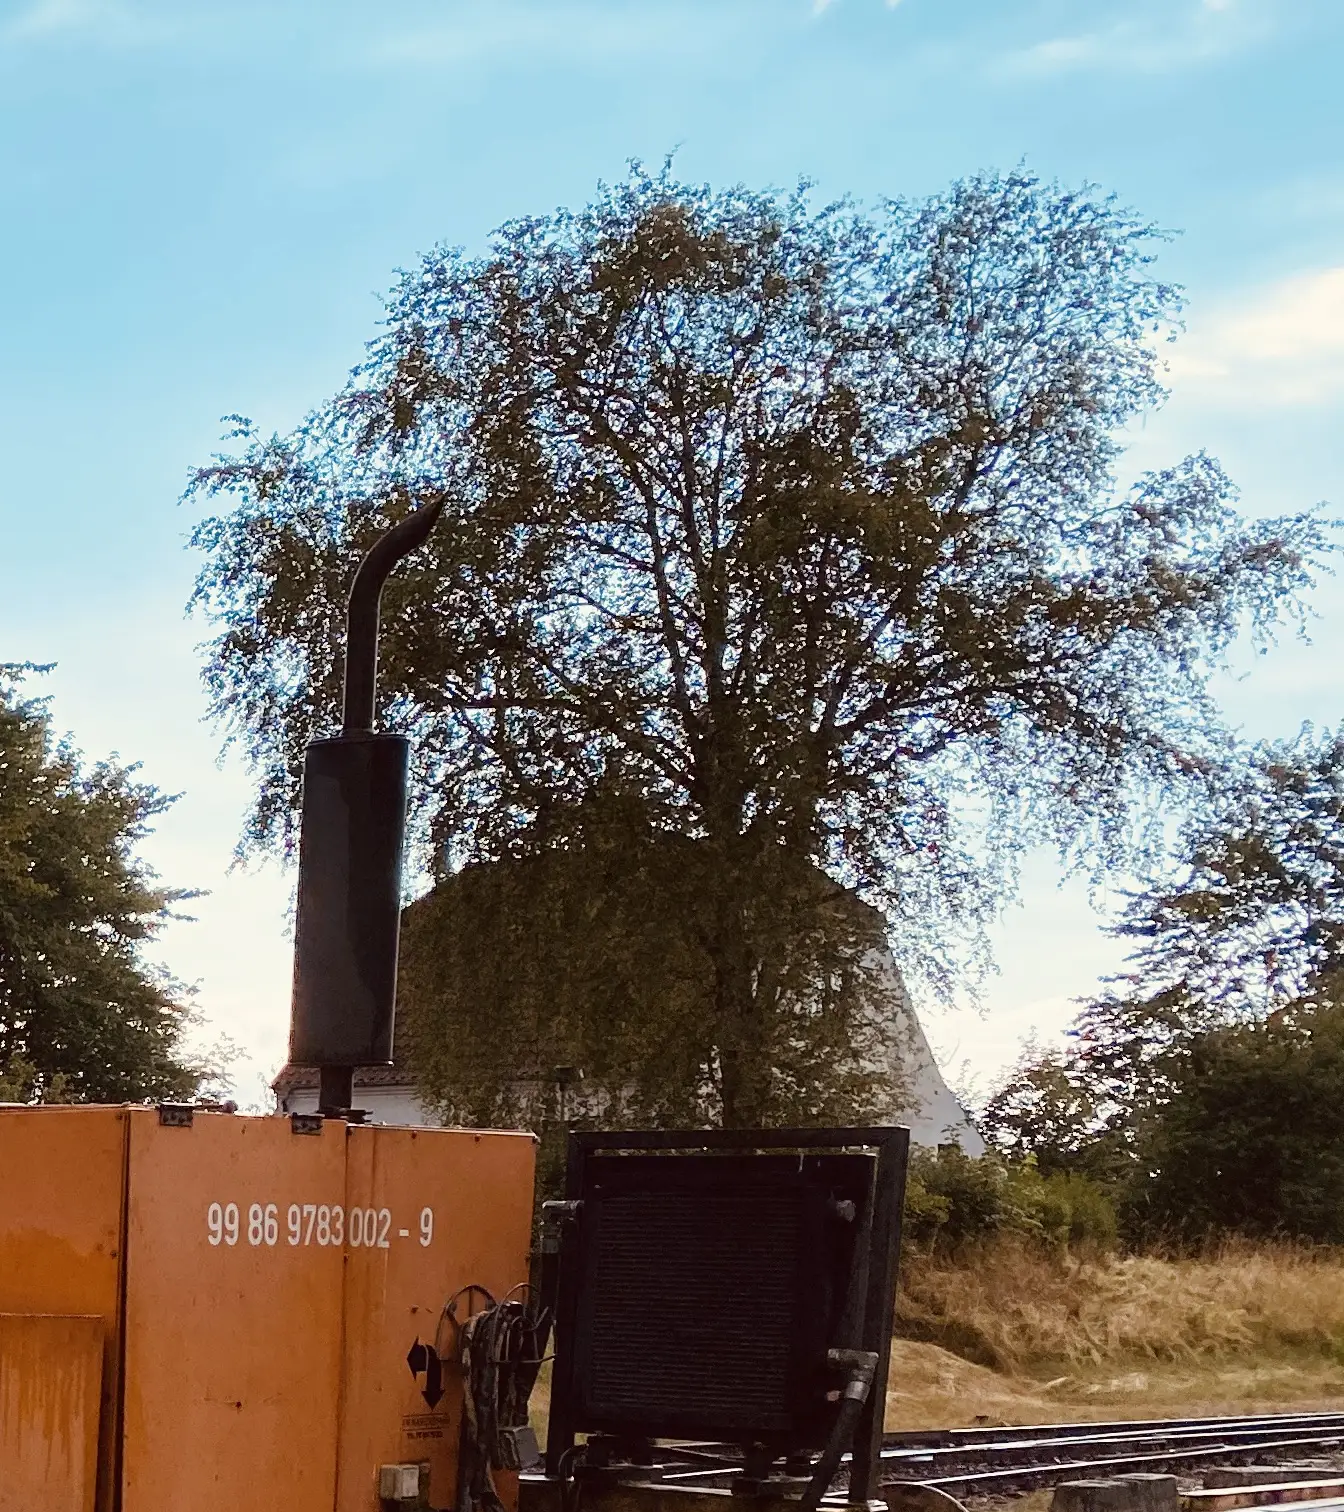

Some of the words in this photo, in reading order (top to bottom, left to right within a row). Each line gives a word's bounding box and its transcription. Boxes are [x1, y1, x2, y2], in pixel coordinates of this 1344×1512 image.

[208, 1202, 239, 1246] 99
[247, 1203, 279, 1246] 86
[287, 1203, 345, 1246] 9783
[349, 1206, 392, 1249] 002
[419, 1206, 434, 1248] 9
